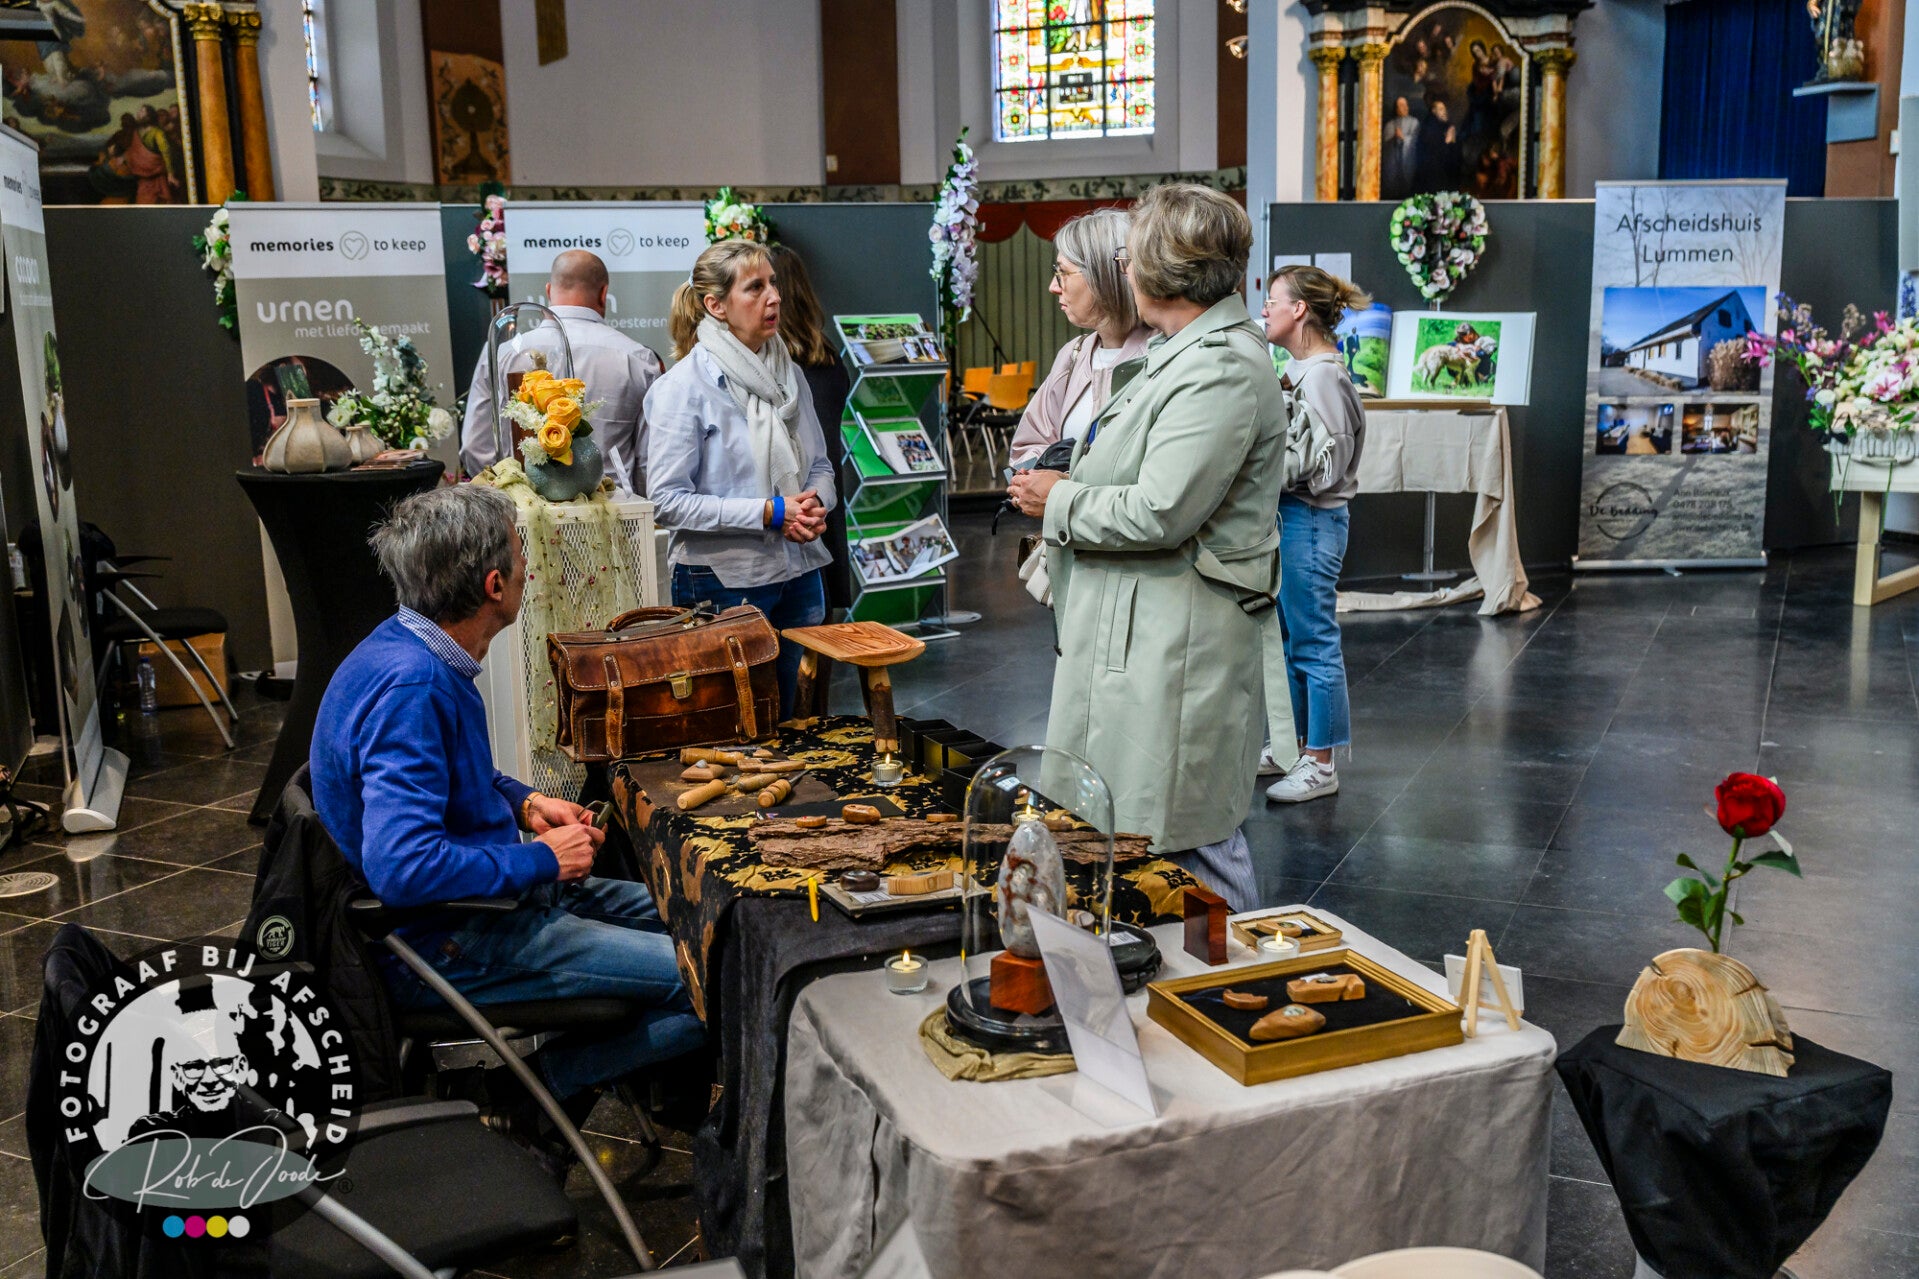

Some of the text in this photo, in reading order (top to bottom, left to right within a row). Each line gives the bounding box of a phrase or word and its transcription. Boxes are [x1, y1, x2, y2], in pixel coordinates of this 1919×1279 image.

[1616, 212, 1762, 232] Afscheidshuis
[250, 238, 426, 252] memories to keep
[523, 235, 690, 249] memories to keep
[1642, 245, 1733, 263] Lummen
[256, 299, 354, 324] urnen
[295, 322, 430, 338] met liefd emaakt
